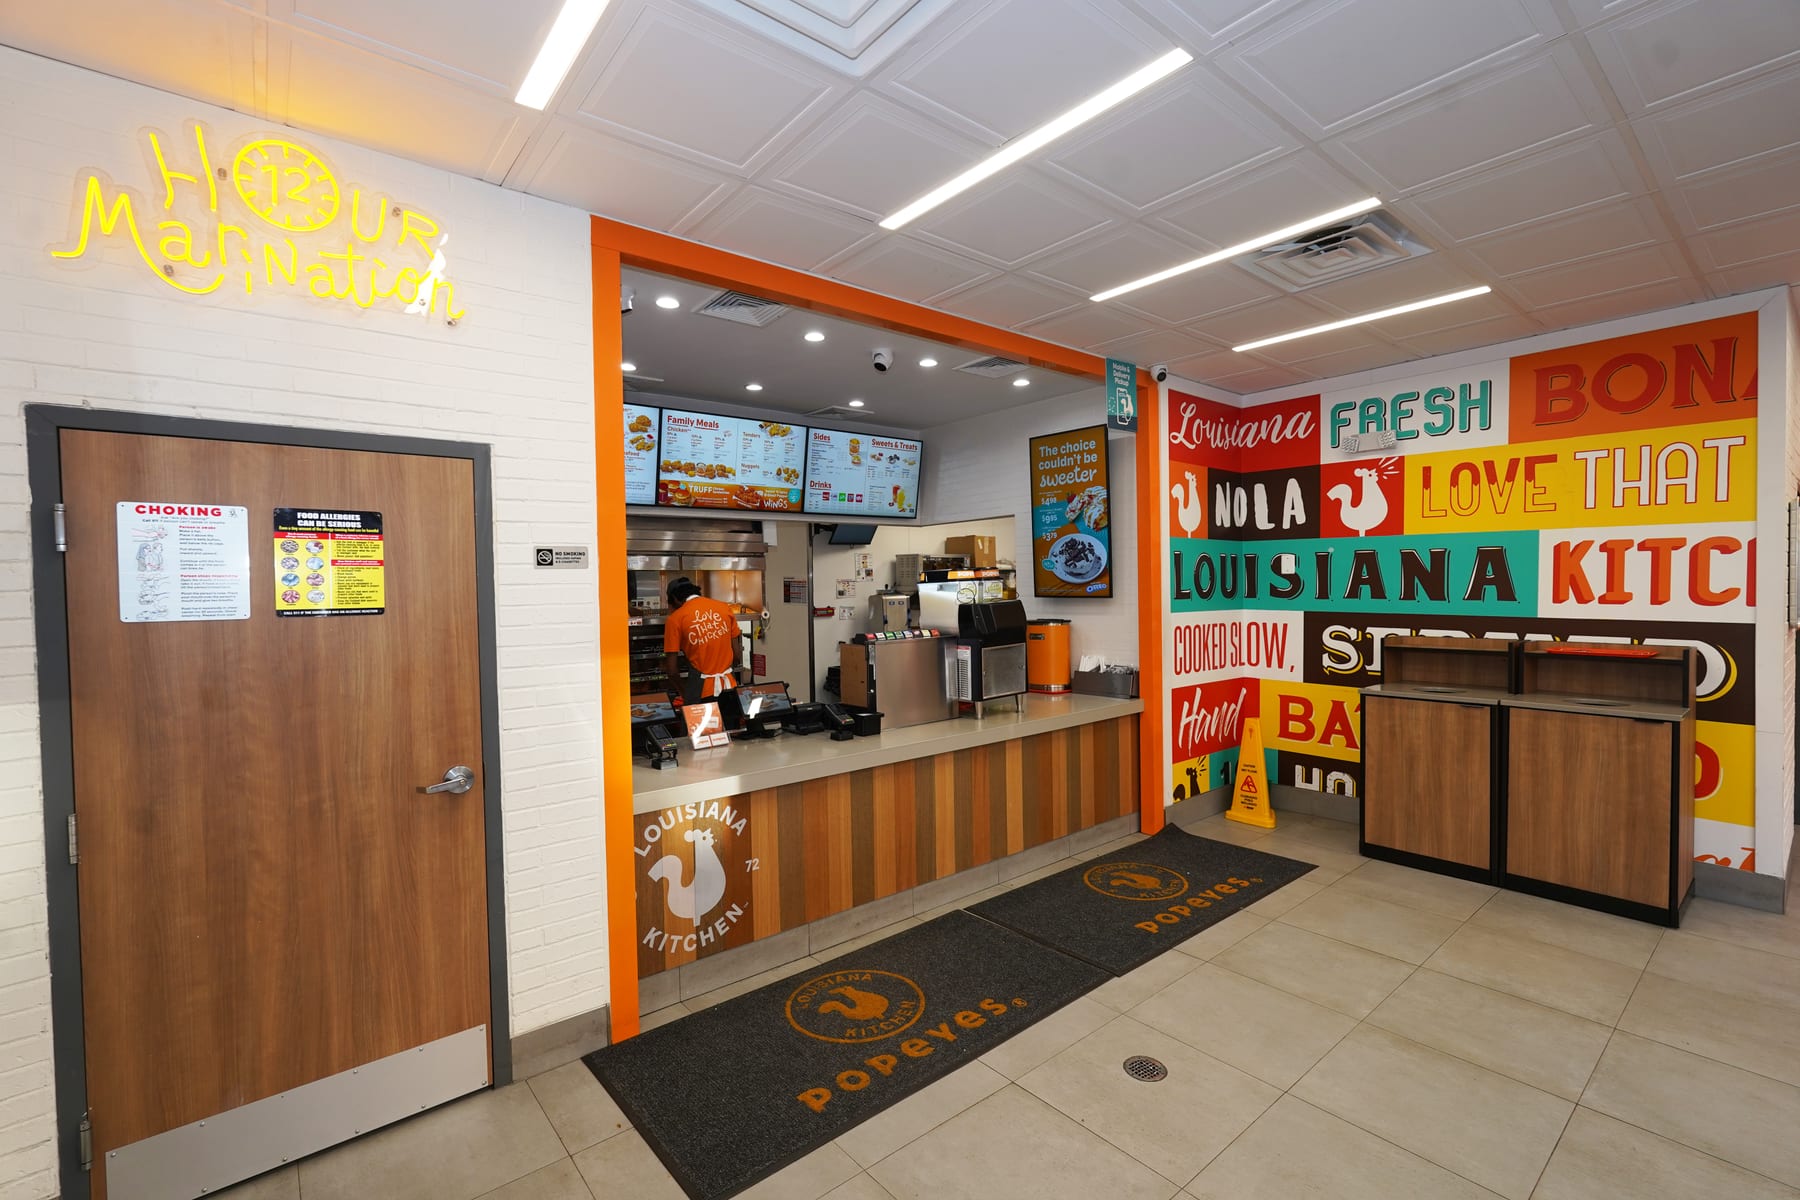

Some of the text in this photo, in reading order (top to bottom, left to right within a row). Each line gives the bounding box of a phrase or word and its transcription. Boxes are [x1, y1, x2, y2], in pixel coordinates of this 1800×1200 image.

[261, 164, 312, 207] 12
[1532, 336, 1758, 427] BON
[667, 415, 720, 429] Family Meals
[813, 432, 831, 441] Sides
[1169, 401, 1316, 450] Louisiana
[1330, 379, 1492, 449] FRESH
[871, 438, 894, 448] Sweets
[899, 443, 918, 451] Treats
[1039, 439, 1096, 457] The choice
[1039, 452, 1098, 470] couldn't be
[809, 480, 832, 489] Drinks
[1039, 465, 1098, 488] sweeter
[1421, 435, 1747, 518] LOVE THAT
[135, 504, 222, 517] CHOKING
[320, 513, 361, 521] ALLERGIES
[1214, 477, 1307, 531] NOLA
[1173, 546, 1521, 604] LOUISIANA
[1552, 536, 1757, 607] KITC
[1174, 621, 1295, 676] COOKED SLOW,
[1177, 687, 1247, 757] Hand
[634, 801, 747, 857] LOUISIANA
[745, 858, 760, 872] 72
[642, 903, 744, 953] KITCHEN
